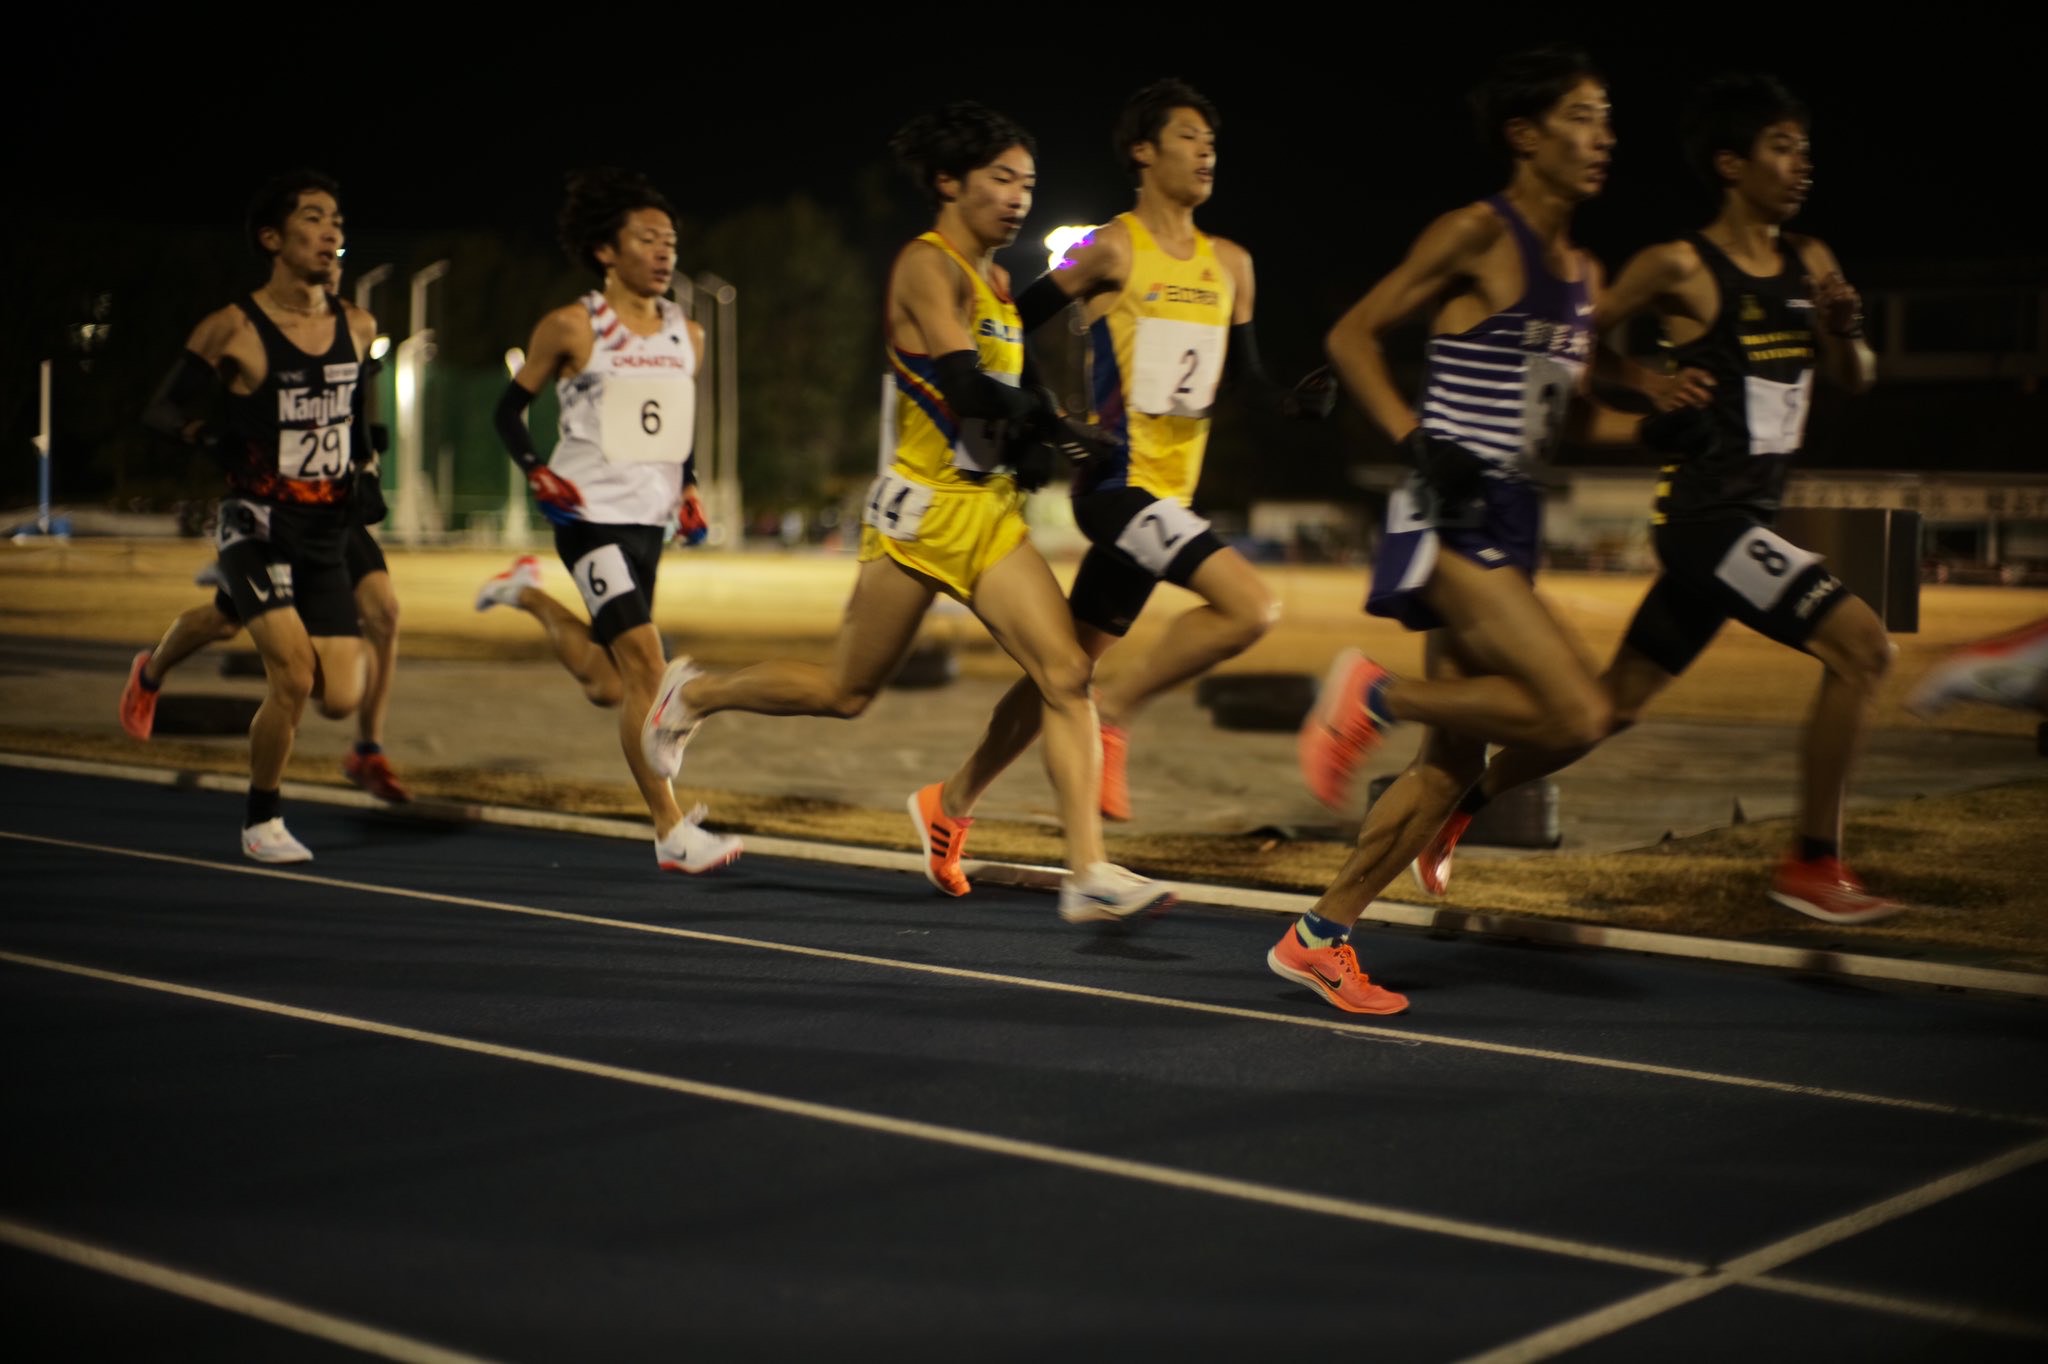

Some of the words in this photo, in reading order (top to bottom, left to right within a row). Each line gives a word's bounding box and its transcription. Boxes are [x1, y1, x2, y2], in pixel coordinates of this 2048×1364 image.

[1175, 349, 1199, 394] 2
[641, 400, 661, 435] 6
[299, 428, 342, 478] 29
[1140, 513, 1182, 550] 2
[1746, 538, 1789, 578] 8
[588, 561, 607, 596] 6
